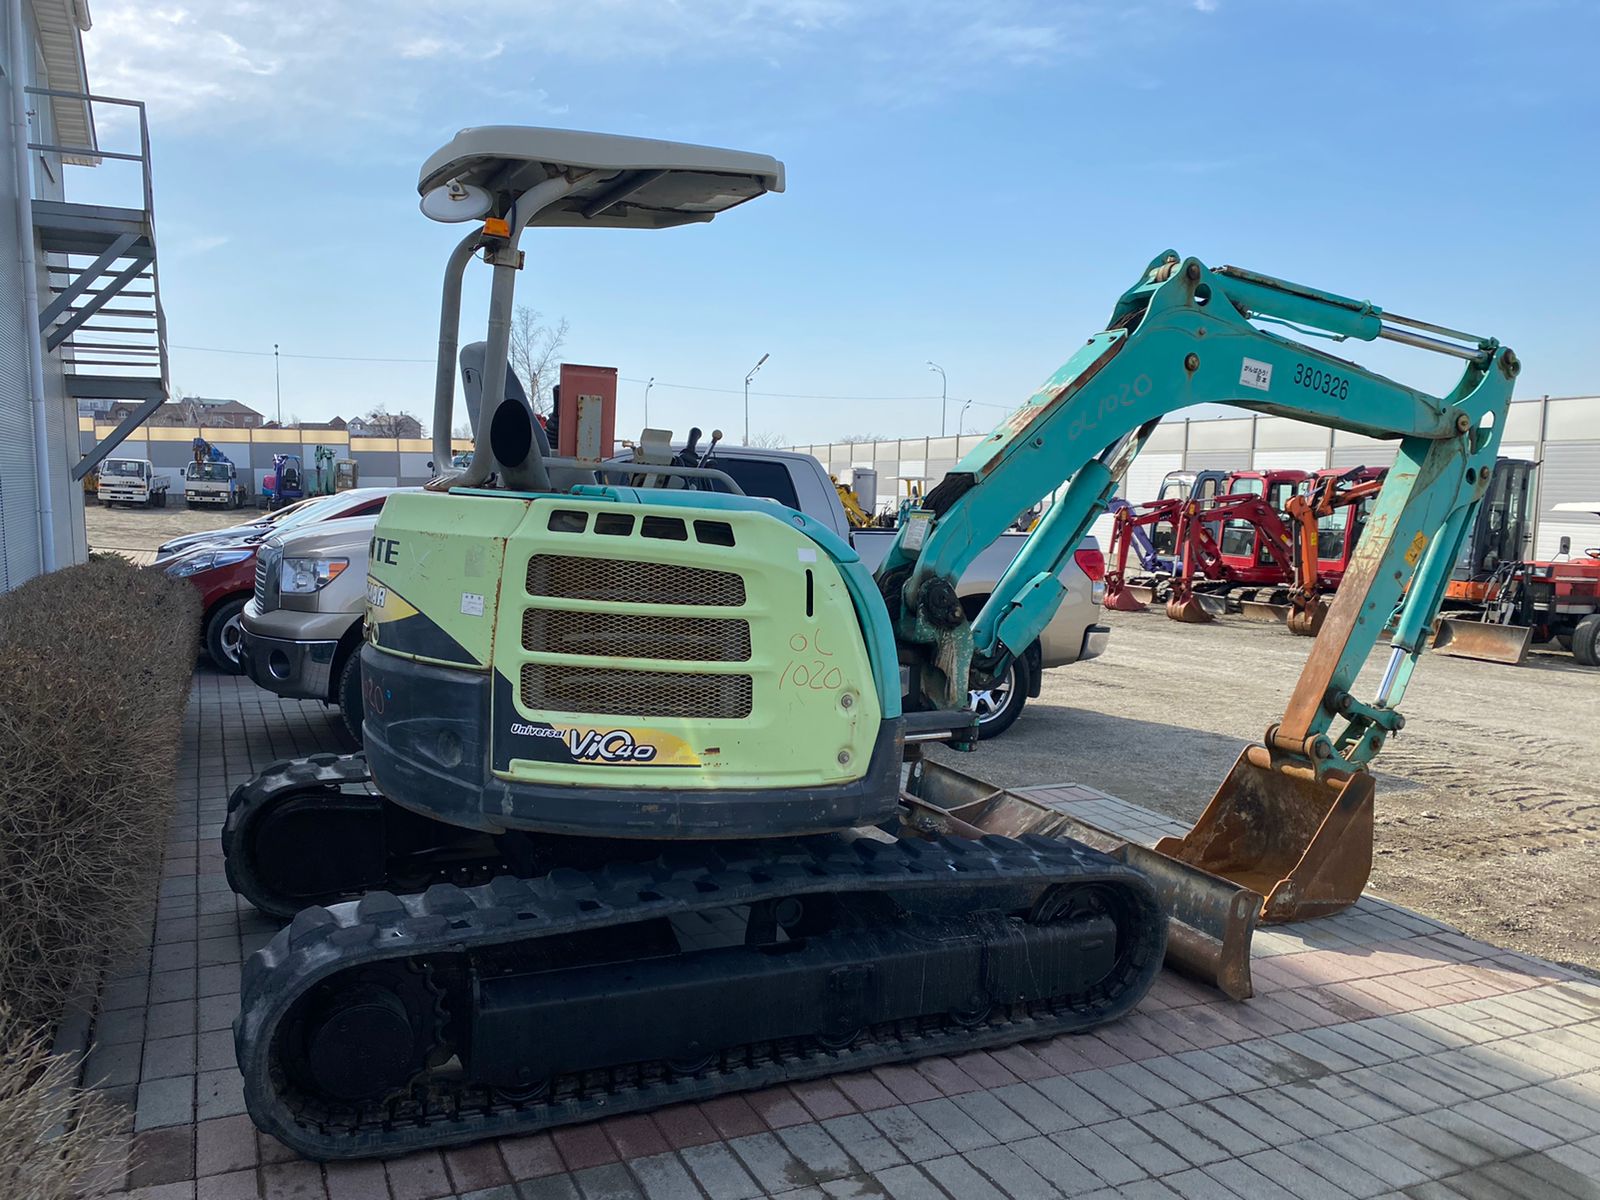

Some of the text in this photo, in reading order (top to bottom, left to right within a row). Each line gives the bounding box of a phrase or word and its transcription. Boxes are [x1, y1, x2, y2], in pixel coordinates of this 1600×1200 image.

[1294, 362, 1349, 401] 380326
[779, 660, 842, 690] 1020
[510, 722, 567, 739] Universal
